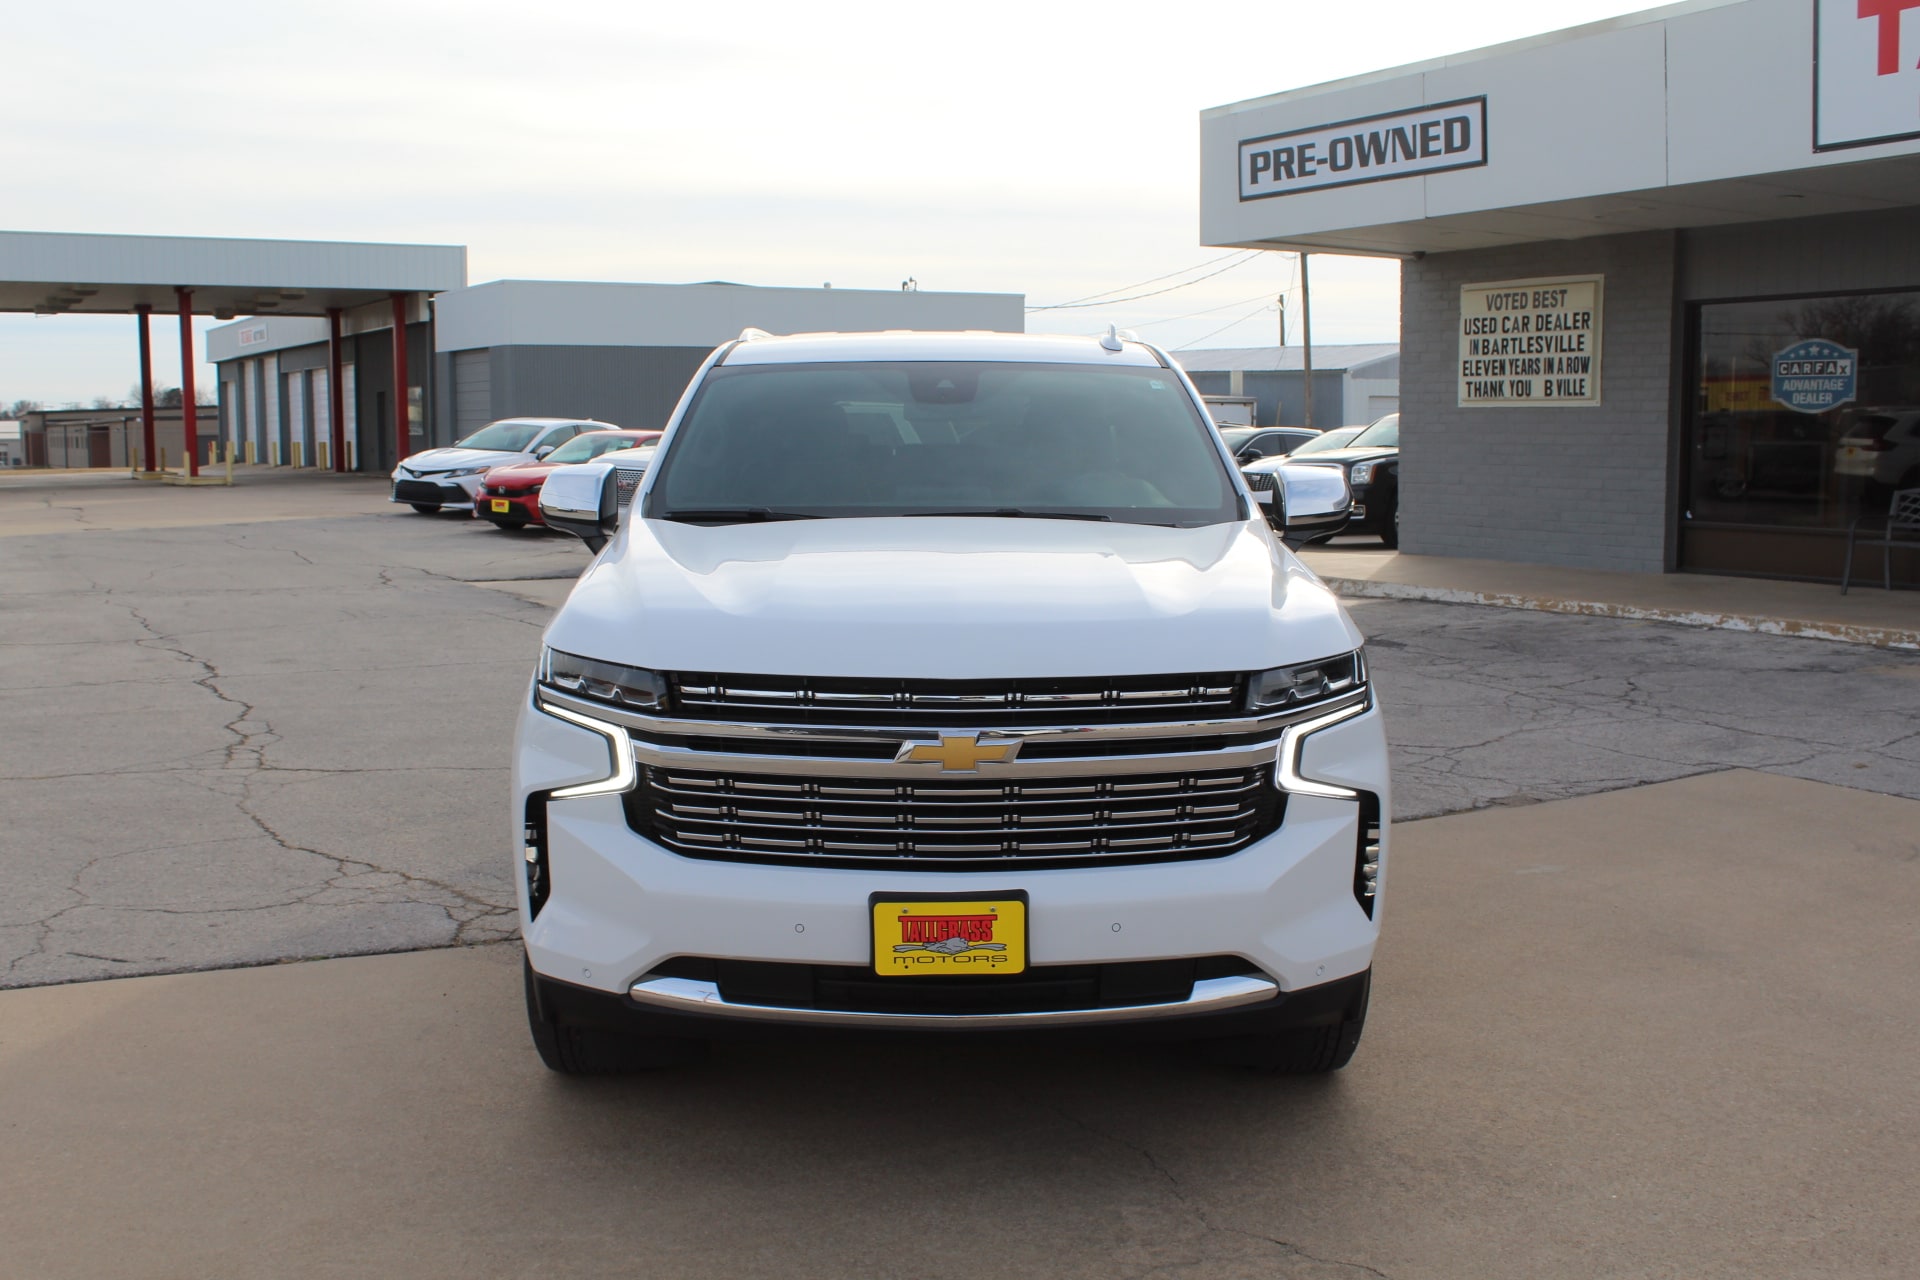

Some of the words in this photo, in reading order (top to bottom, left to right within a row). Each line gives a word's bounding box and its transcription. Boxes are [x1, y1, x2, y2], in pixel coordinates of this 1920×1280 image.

[1249, 115, 1471, 185] PRE-OWNED
[1486, 292, 1528, 312] VOTED
[1532, 289, 1568, 309] BEST
[1464, 317, 1497, 335] USED
[1502, 315, 1530, 333] CAR
[1535, 312, 1591, 332] DEALER
[1469, 339, 1479, 355] IN
[1482, 334, 1585, 355] BARTLESVILLE
[1463, 358, 1506, 377] ELEVEN
[1508, 357, 1540, 375] YEARS
[1543, 357, 1554, 375] IN
[1557, 356, 1564, 374] A
[1566, 356, 1590, 374] ROW
[1779, 361, 1849, 375] CARFAX
[1466, 380, 1504, 398] THANK
[1509, 379, 1532, 397] YOU
[1544, 379, 1553, 396] B
[1556, 378, 1586, 396] VILLE
[1782, 378, 1844, 391] ADVANTAGE
[1792, 392, 1833, 404] DEALER
[898, 914, 998, 943] TALLGRASS
[893, 954, 1008, 965] MOTORS
